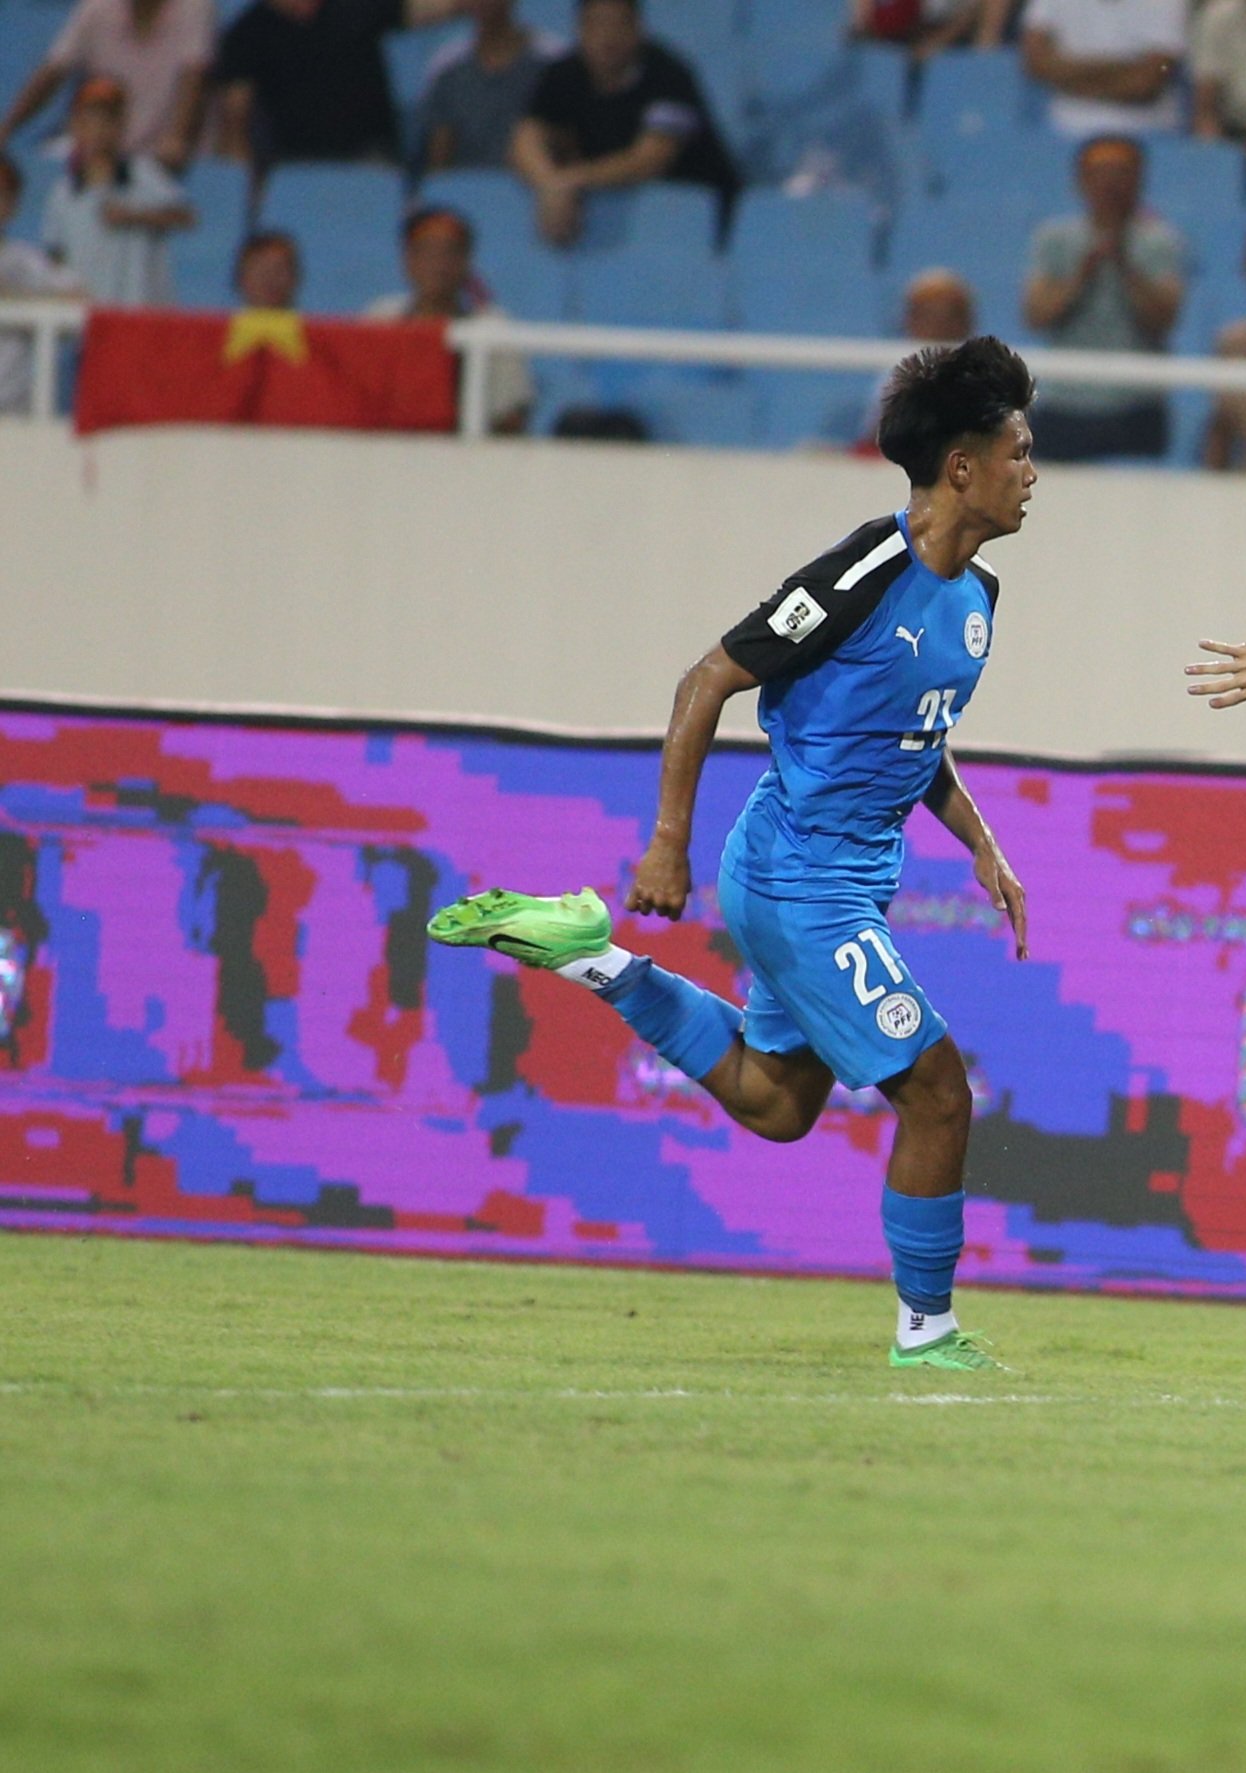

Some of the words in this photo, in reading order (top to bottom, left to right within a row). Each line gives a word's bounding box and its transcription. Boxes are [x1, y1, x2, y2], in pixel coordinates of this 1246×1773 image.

[899, 689, 957, 751] 21
[834, 928, 904, 1006] 21
[909, 1311, 926, 1332] NE
